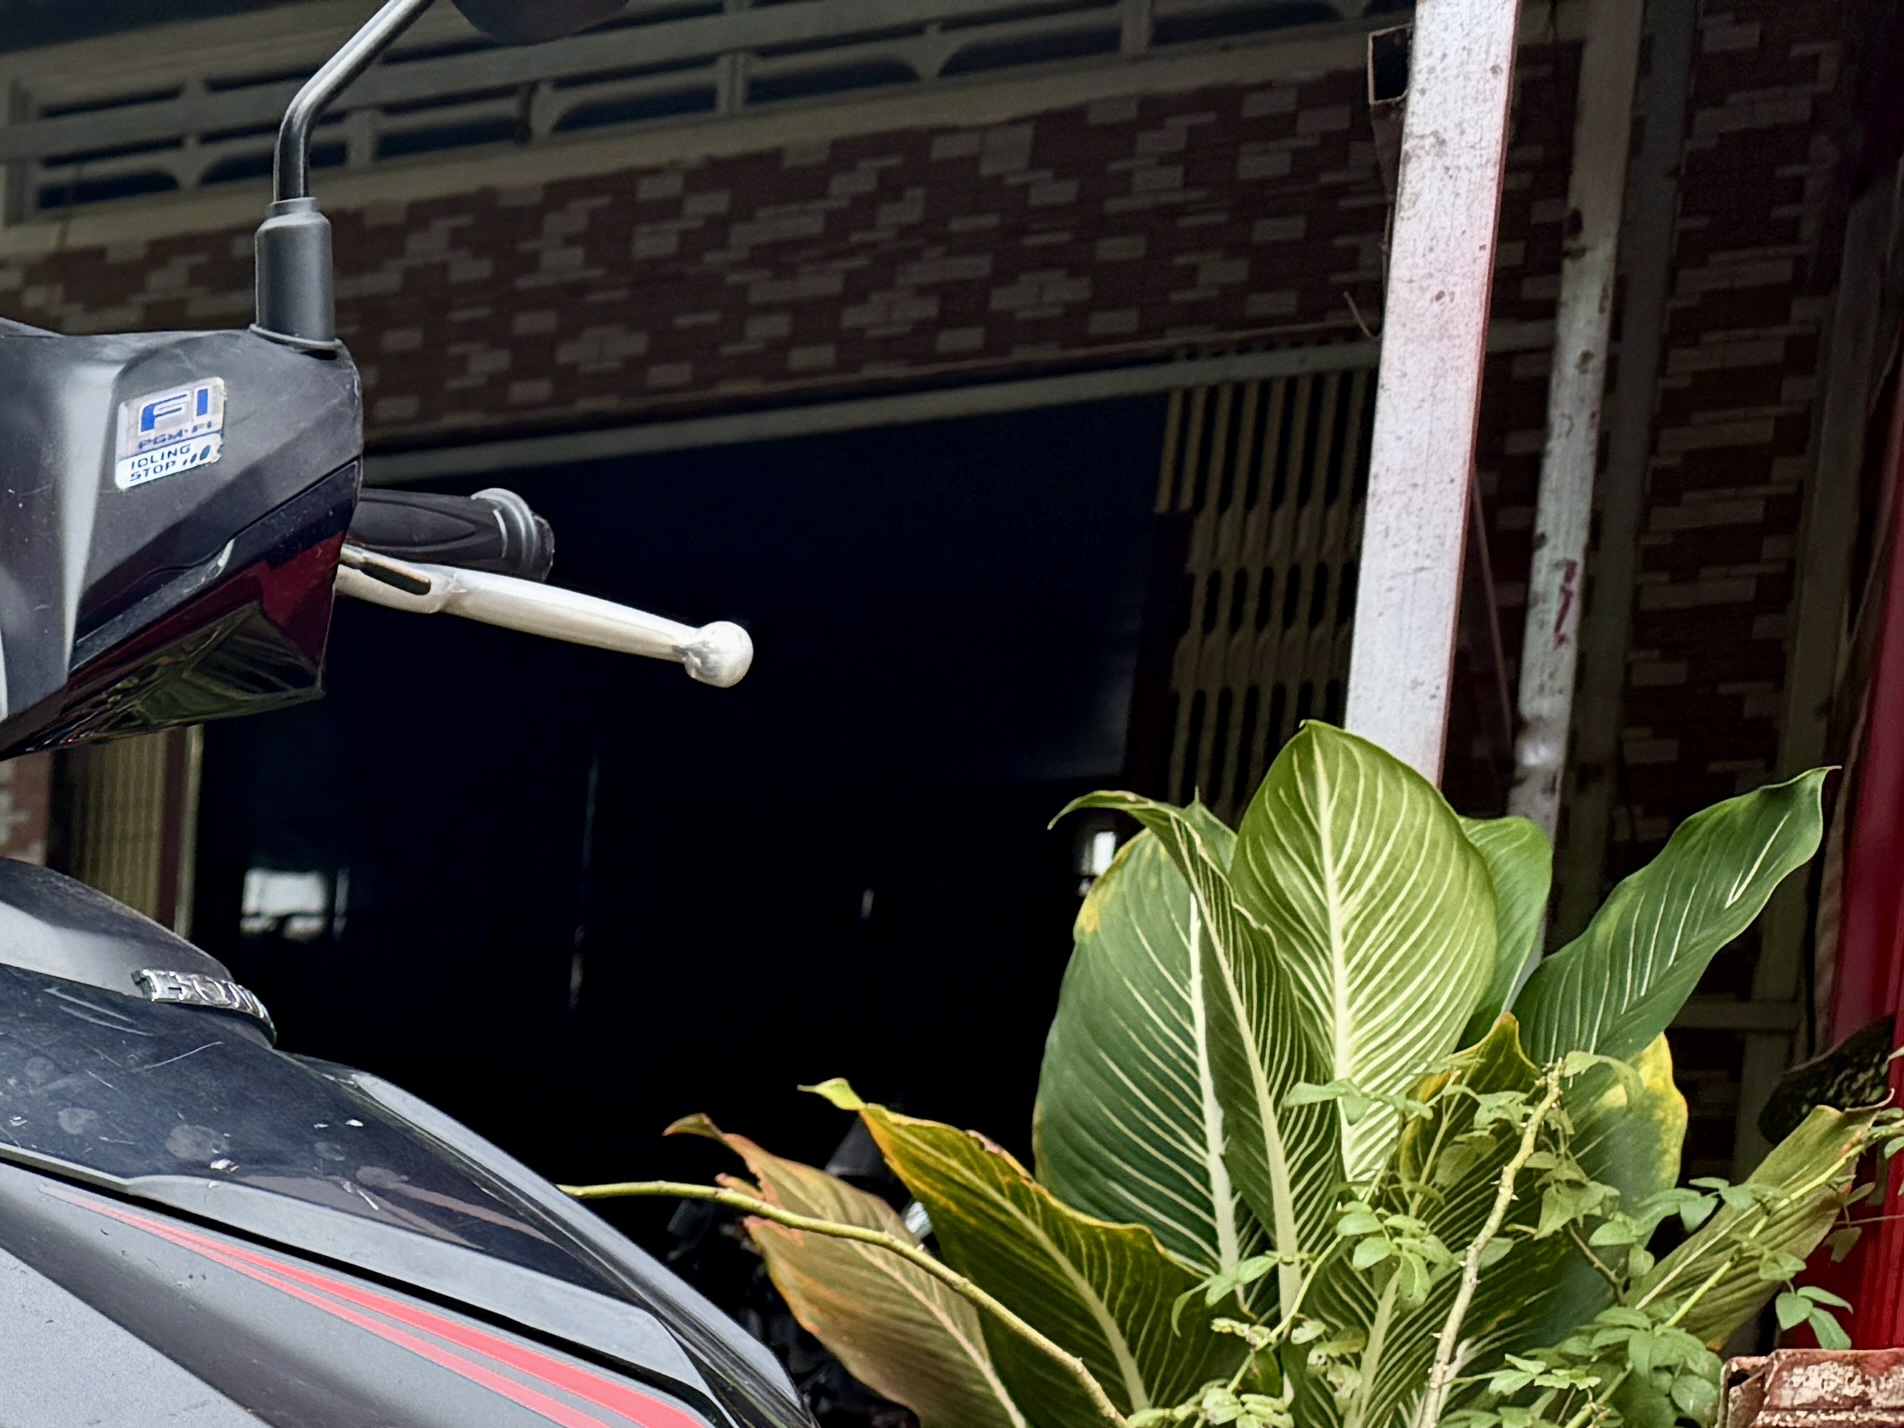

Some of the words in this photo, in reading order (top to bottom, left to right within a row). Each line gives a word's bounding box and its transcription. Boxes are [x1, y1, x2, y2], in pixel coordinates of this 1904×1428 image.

[138, 387, 210, 433] FI
[130, 444, 192, 471] IDLING
[130, 460, 176, 482] STOP
